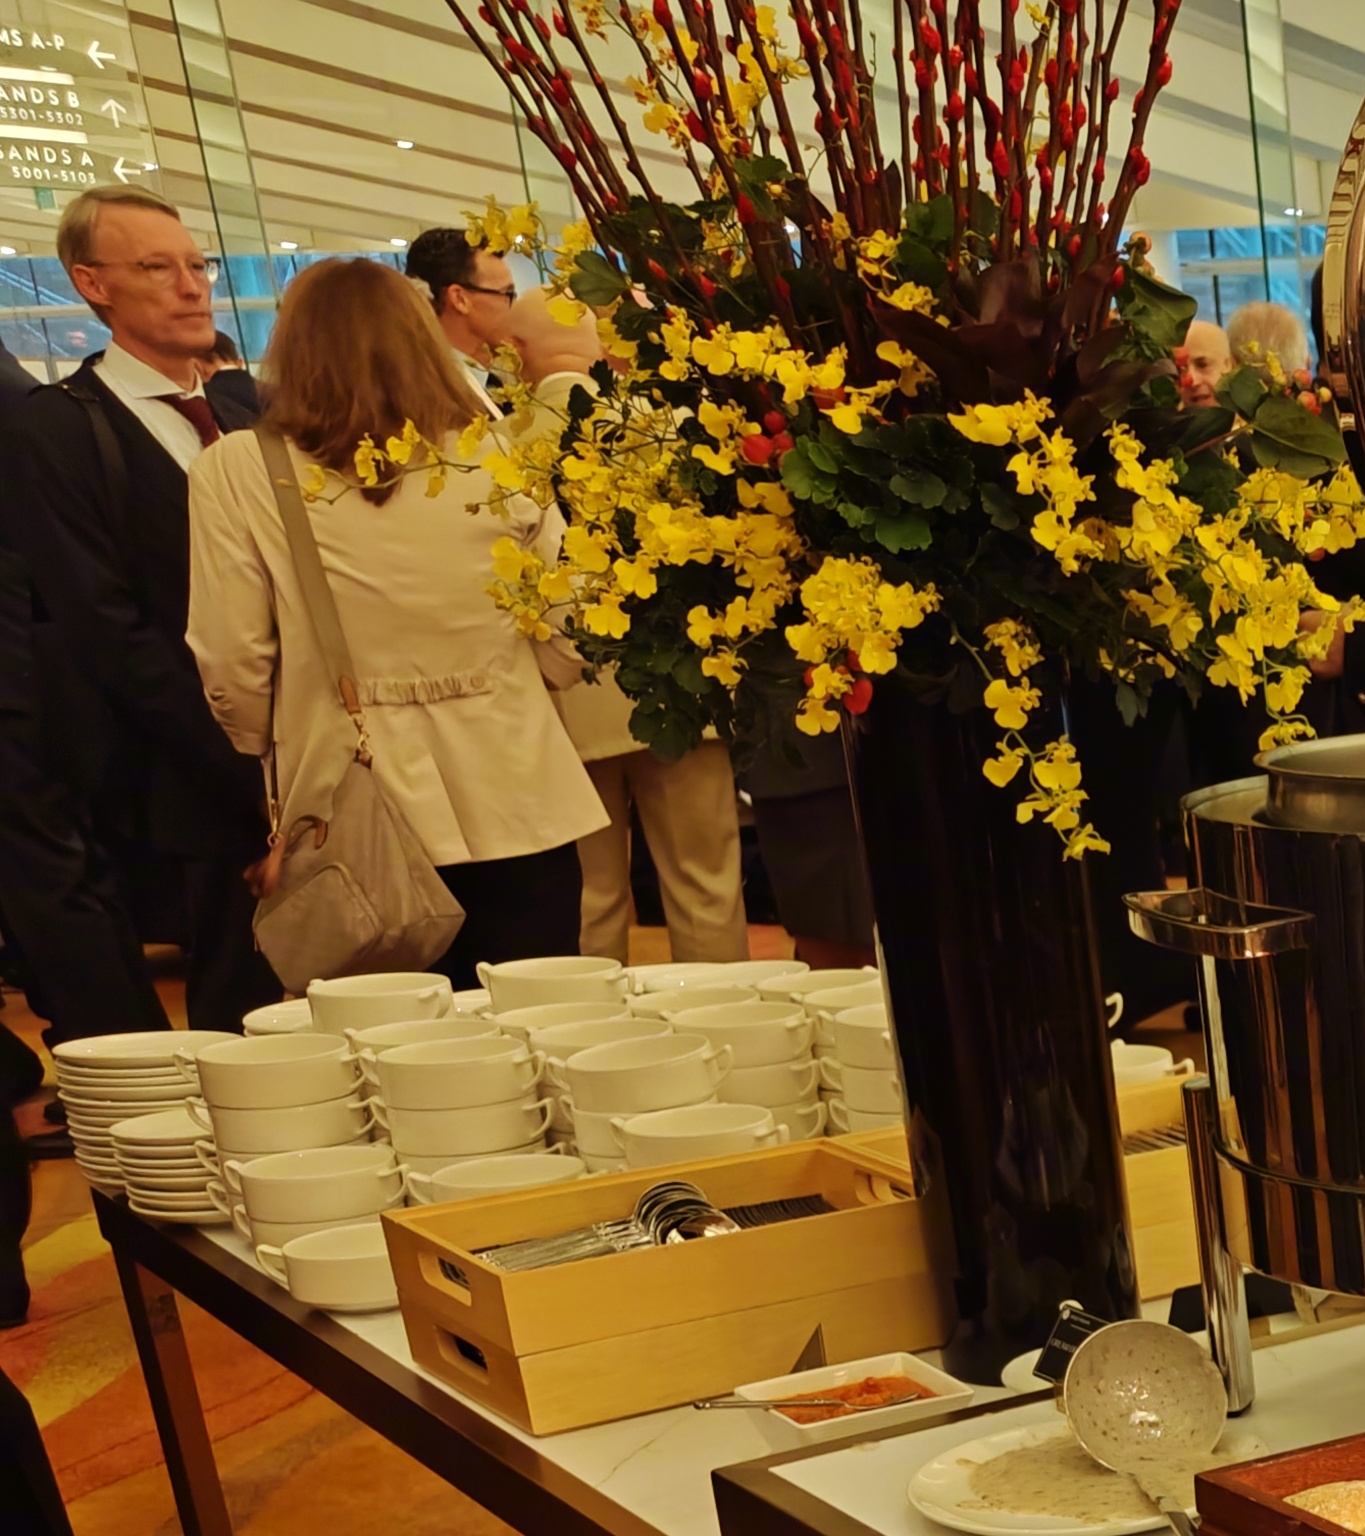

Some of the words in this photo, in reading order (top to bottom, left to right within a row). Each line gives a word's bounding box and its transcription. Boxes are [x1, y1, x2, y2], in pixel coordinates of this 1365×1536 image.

[31, 32, 65, 51] A-P
[67, 90, 80, 108] B
[0, 105, 84, 126] 5301-5302
[81, 151, 94, 167] A
[12, 166, 96, 185] 5001-5103
